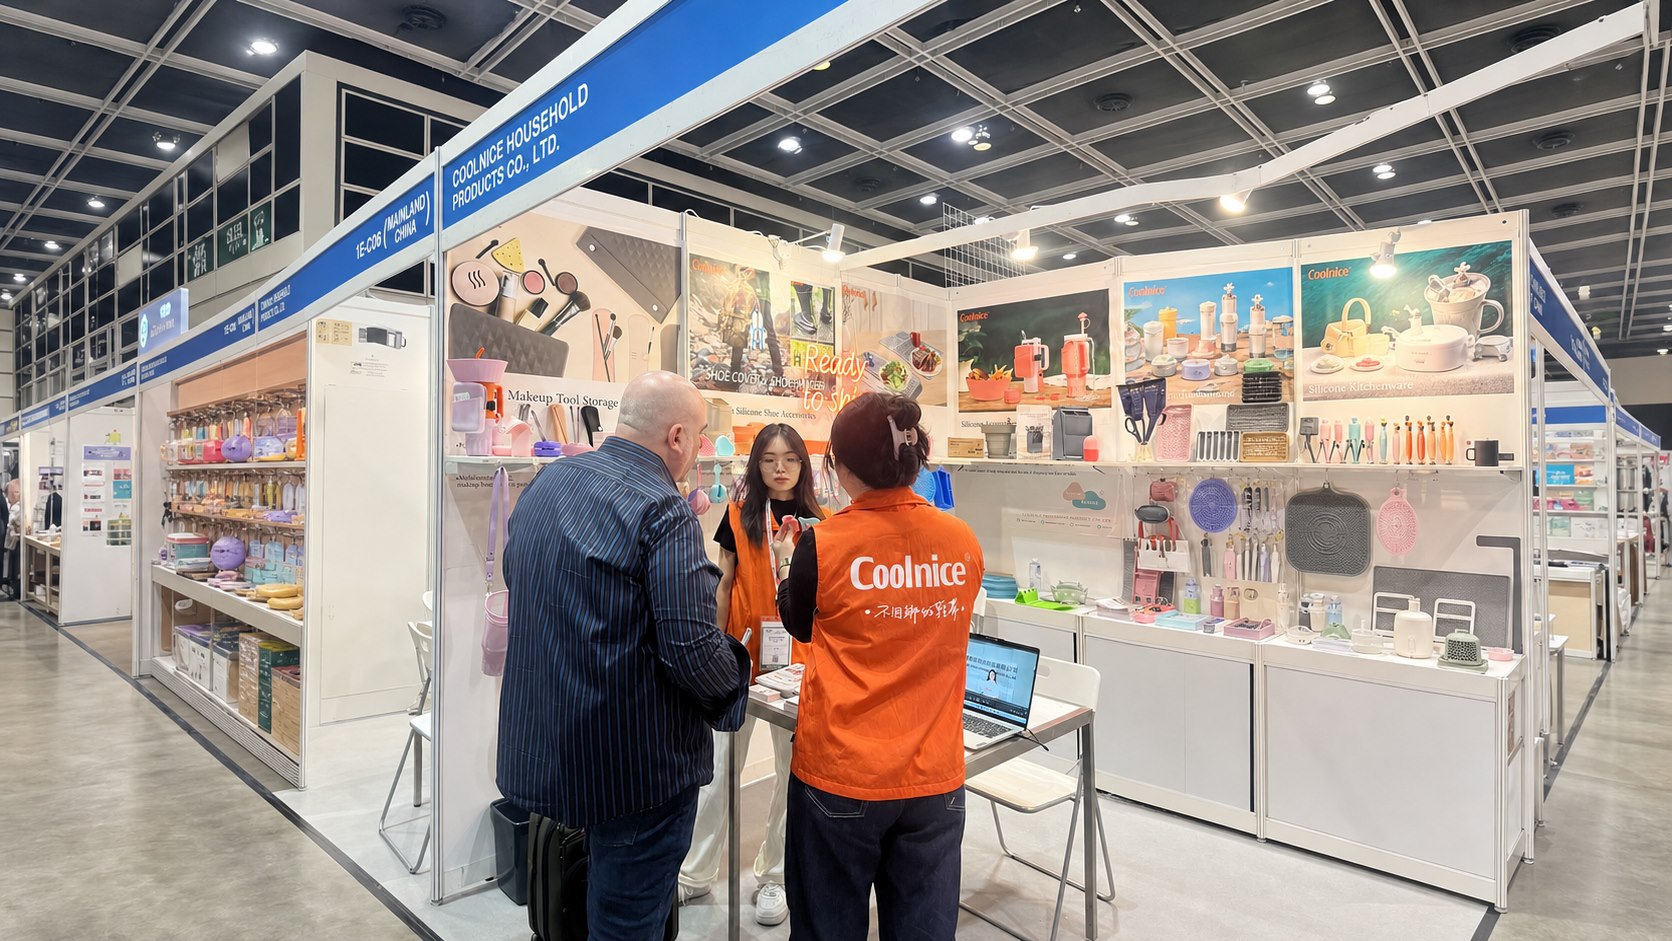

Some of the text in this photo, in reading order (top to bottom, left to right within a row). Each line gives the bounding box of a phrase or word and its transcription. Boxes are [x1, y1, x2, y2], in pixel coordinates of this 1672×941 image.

[452, 83, 589, 188] COOLNICE HOUSEHOLD
[452, 133, 560, 211] PRODUCTS CO., LTD.
[394, 219, 417, 243] CHINA
[355, 231, 382, 260] 1E-C06
[1308, 267, 1350, 281] Coolnice
[705, 370, 730, 382] SHOE
[805, 344, 869, 382] Ready
[804, 380, 824, 411] to
[1308, 380, 1414, 394] Silicone Kitchenware
[508, 390, 619, 411] Makeup Tool Storage
[736, 407, 762, 416] Silicone
[850, 554, 966, 590] Coolnice
